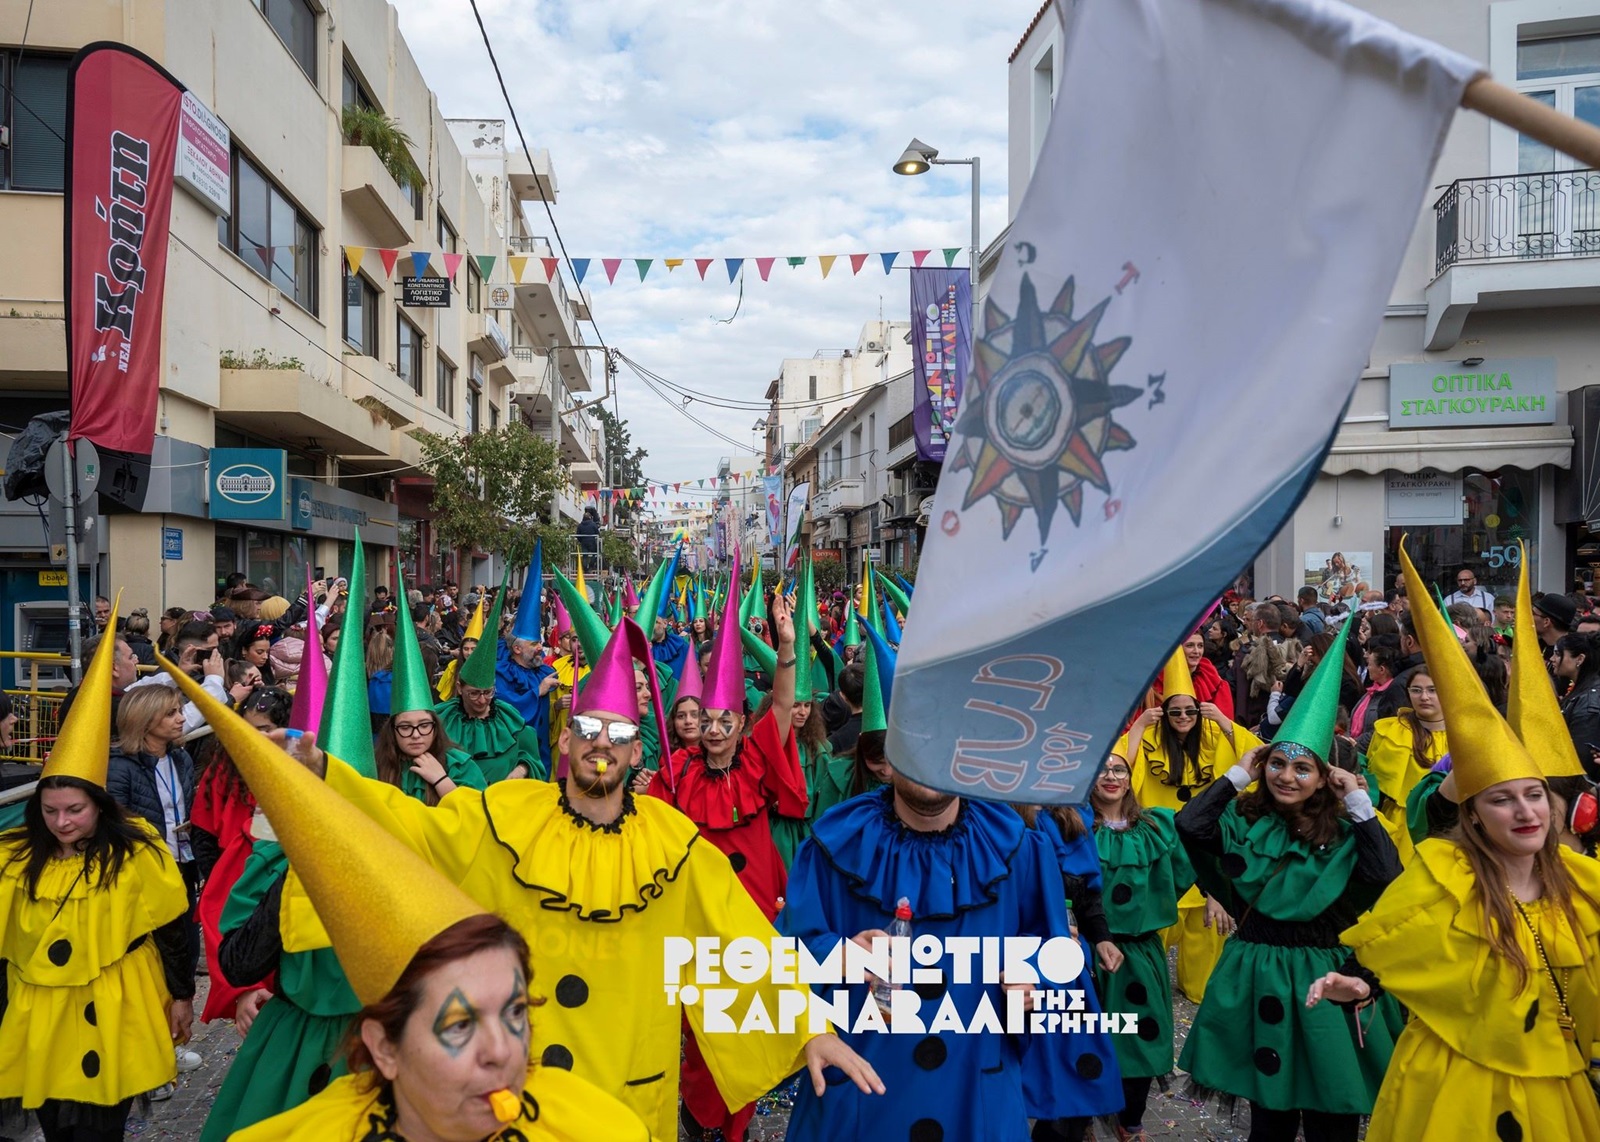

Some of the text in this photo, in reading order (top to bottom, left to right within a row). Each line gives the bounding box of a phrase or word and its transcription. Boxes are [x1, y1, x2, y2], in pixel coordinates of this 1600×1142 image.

[118, 342, 131, 373] ΝΕΑ
[1432, 371, 1512, 393] ΟΠΤΙΚΑ
[1400, 395, 1546, 415] ΣΤΑΓΚΟΥΡΑΚΗ
[1403, 472, 1438, 480] ΟΠΤΙΚΑ
